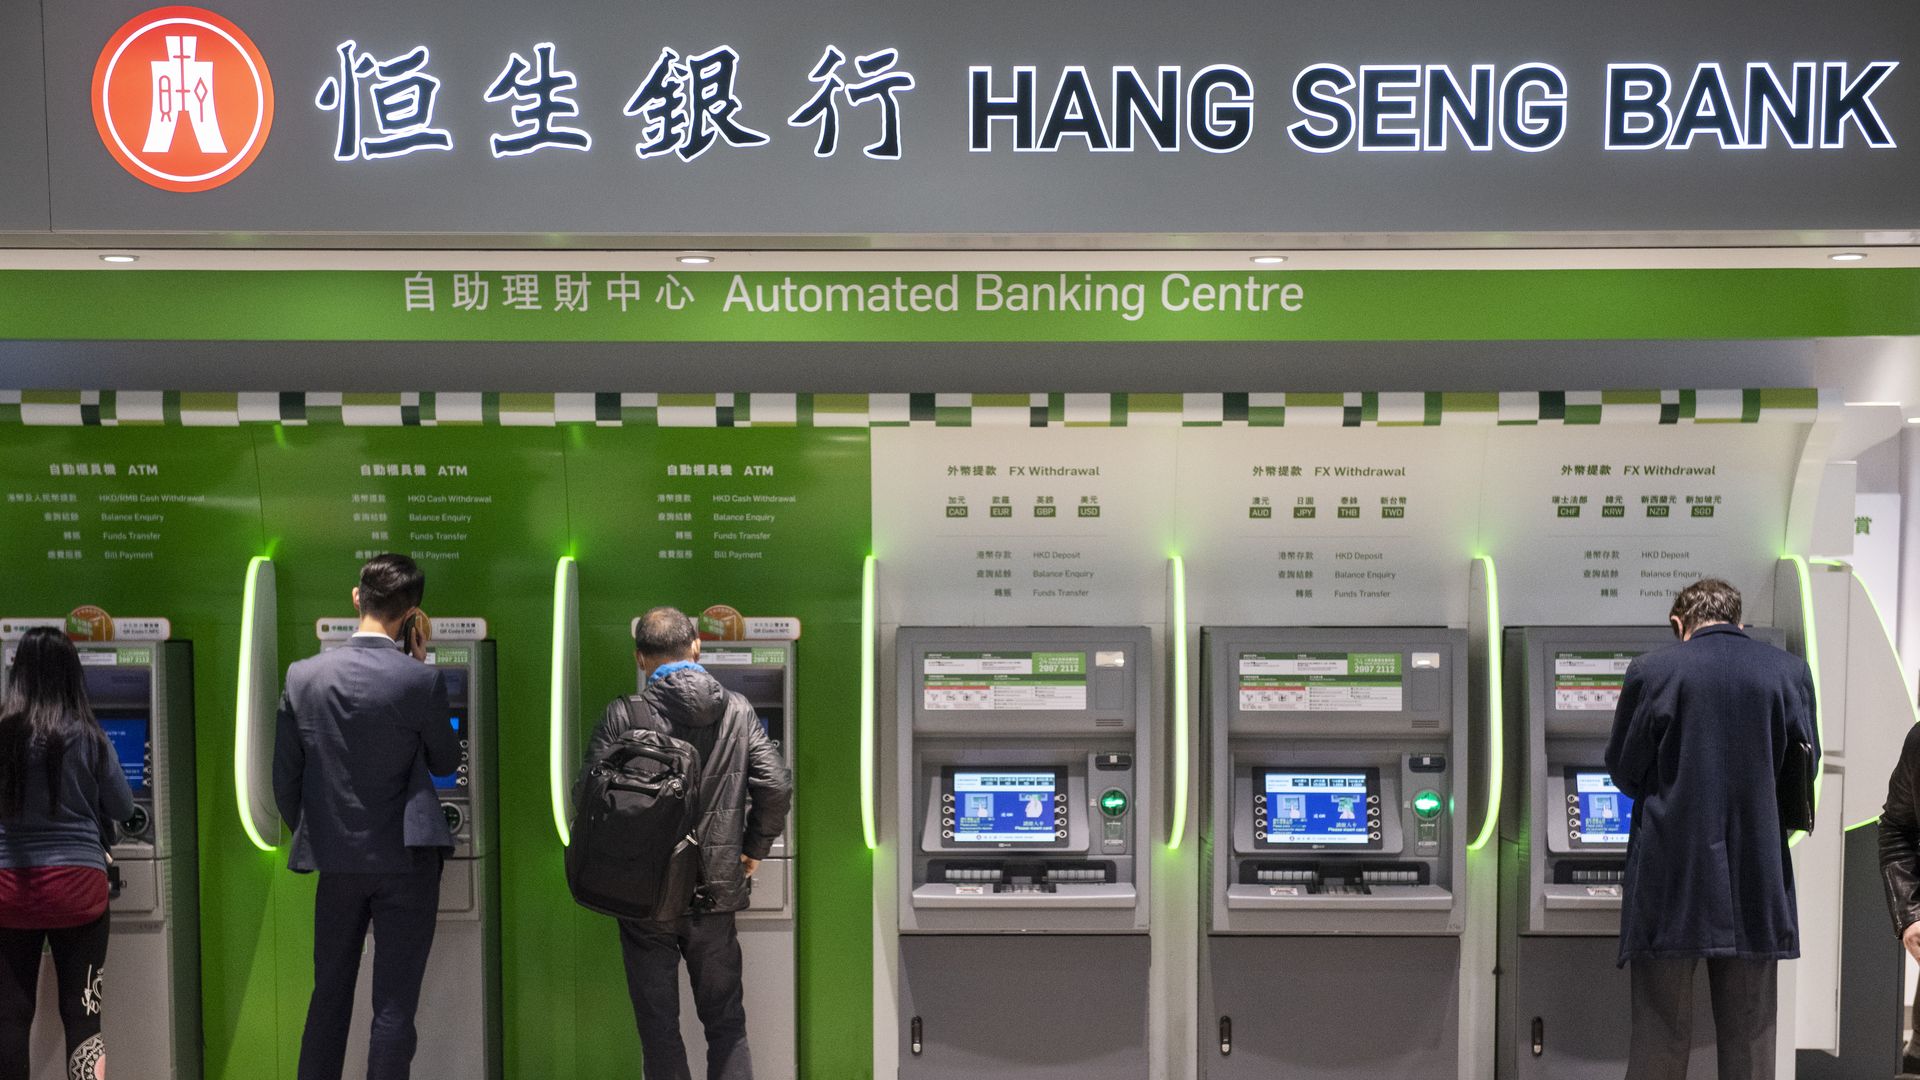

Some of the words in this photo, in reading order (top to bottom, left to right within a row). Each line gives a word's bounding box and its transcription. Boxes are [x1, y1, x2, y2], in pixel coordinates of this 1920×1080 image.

[314, 39, 915, 162] 恒生銀行
[968, 64, 1255, 154] HANG
[1287, 62, 1568, 153] SENG
[1604, 61, 1899, 152] BANK
[403, 271, 695, 312] 自助理財中心
[722, 274, 959, 312] Automated
[975, 273, 1145, 321] Banking
[1161, 273, 1304, 312] Centre
[128, 464, 158, 476] ATM
[438, 466, 468, 476] ATM
[744, 466, 774, 476] ATM
[948, 466, 997, 476] 外幣提款
[1009, 466, 1025, 476] FX
[1029, 466, 1100, 476] Withdrawal
[1252, 466, 1302, 476] 外幣提款
[1314, 467, 1330, 476] FX
[1334, 466, 1406, 476] Withdrawal
[1561, 464, 1612, 476] 外幣提款
[1624, 466, 1640, 476] FX
[1644, 466, 1716, 476] Withdrawal
[140, 494, 159, 502] Cash
[161, 494, 205, 502] Withdrawal
[427, 495, 446, 503] Cash
[448, 495, 492, 503] Withdrawal
[948, 508, 966, 516] CAD
[992, 508, 1010, 516] EUR
[1036, 508, 1054, 516] GBP
[1080, 508, 1098, 516] USD
[1252, 508, 1269, 516] AUD
[1296, 508, 1312, 516] JPY
[1340, 508, 1357, 516] THB
[1384, 508, 1402, 516] TWD
[1560, 507, 1578, 516] CHF
[1604, 507, 1622, 516] KRW
[1650, 507, 1666, 516] NZD
[1694, 507, 1712, 516] SGD
[102, 513, 132, 522] Balance
[134, 513, 164, 523] Enquiry
[442, 514, 471, 523] Enquiry
[714, 514, 744, 522] Balance
[746, 514, 775, 522] Enquiry
[103, 532, 127, 540] Funds
[129, 532, 160, 540] Transfer
[714, 532, 737, 540] Funds
[739, 532, 771, 540] Transfer
[105, 551, 118, 559] Bill
[120, 551, 153, 560] Payment
[426, 552, 459, 560] Payment
[714, 551, 726, 559] Bill
[729, 551, 762, 560] Payment
[1052, 552, 1080, 560] Deposit
[1354, 553, 1383, 561] Deposit
[1660, 552, 1690, 560] Deposit
[1065, 570, 1094, 579] Enquiry
[1367, 572, 1396, 580] Enquiry
